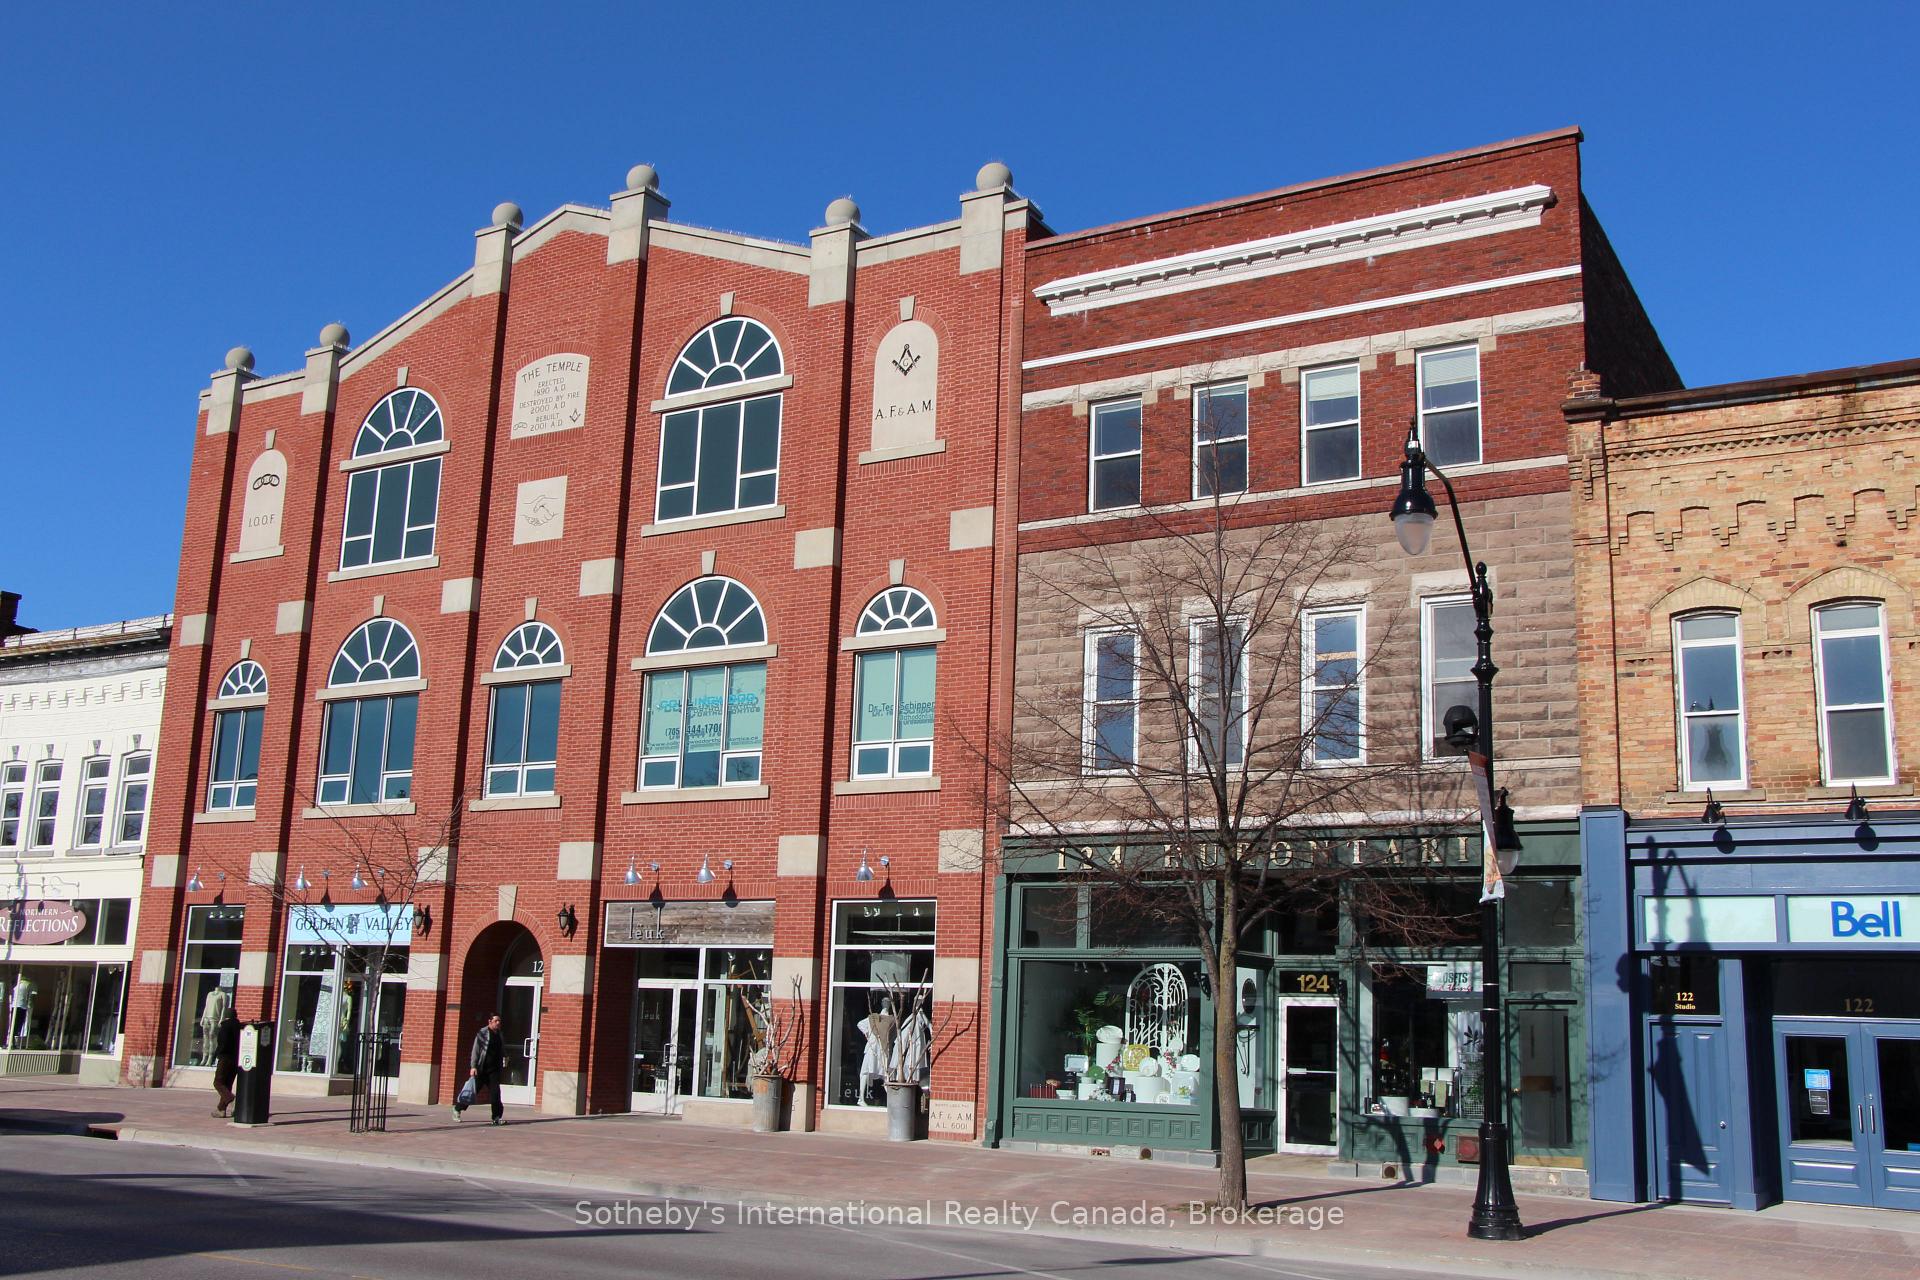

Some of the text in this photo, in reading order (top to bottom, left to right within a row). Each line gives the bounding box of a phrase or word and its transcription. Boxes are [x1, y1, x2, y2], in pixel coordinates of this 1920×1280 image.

[521, 361, 583, 383] THE TEMPLE
[537, 377, 565, 388] ERECTED
[519, 391, 581, 409] DESTROYED BY FIRE
[530, 404, 550, 415] 2000
[535, 412, 560, 423] REBUILT
[530, 424, 547, 432] 2001
[1057, 847, 1122, 870] 124
[20, 907, 58, 916] NORTHERN
[1830, 900, 1902, 937] Bell
[0, 916, 79, 933] REFLECTIONS
[295, 917, 412, 931] GOLDEN VALLEY
[1296, 974, 1330, 992] 124
[1676, 992, 1694, 1002] 122
[1674, 1003, 1696, 1011] Studio
[1844, 998, 1874, 1013] 122
